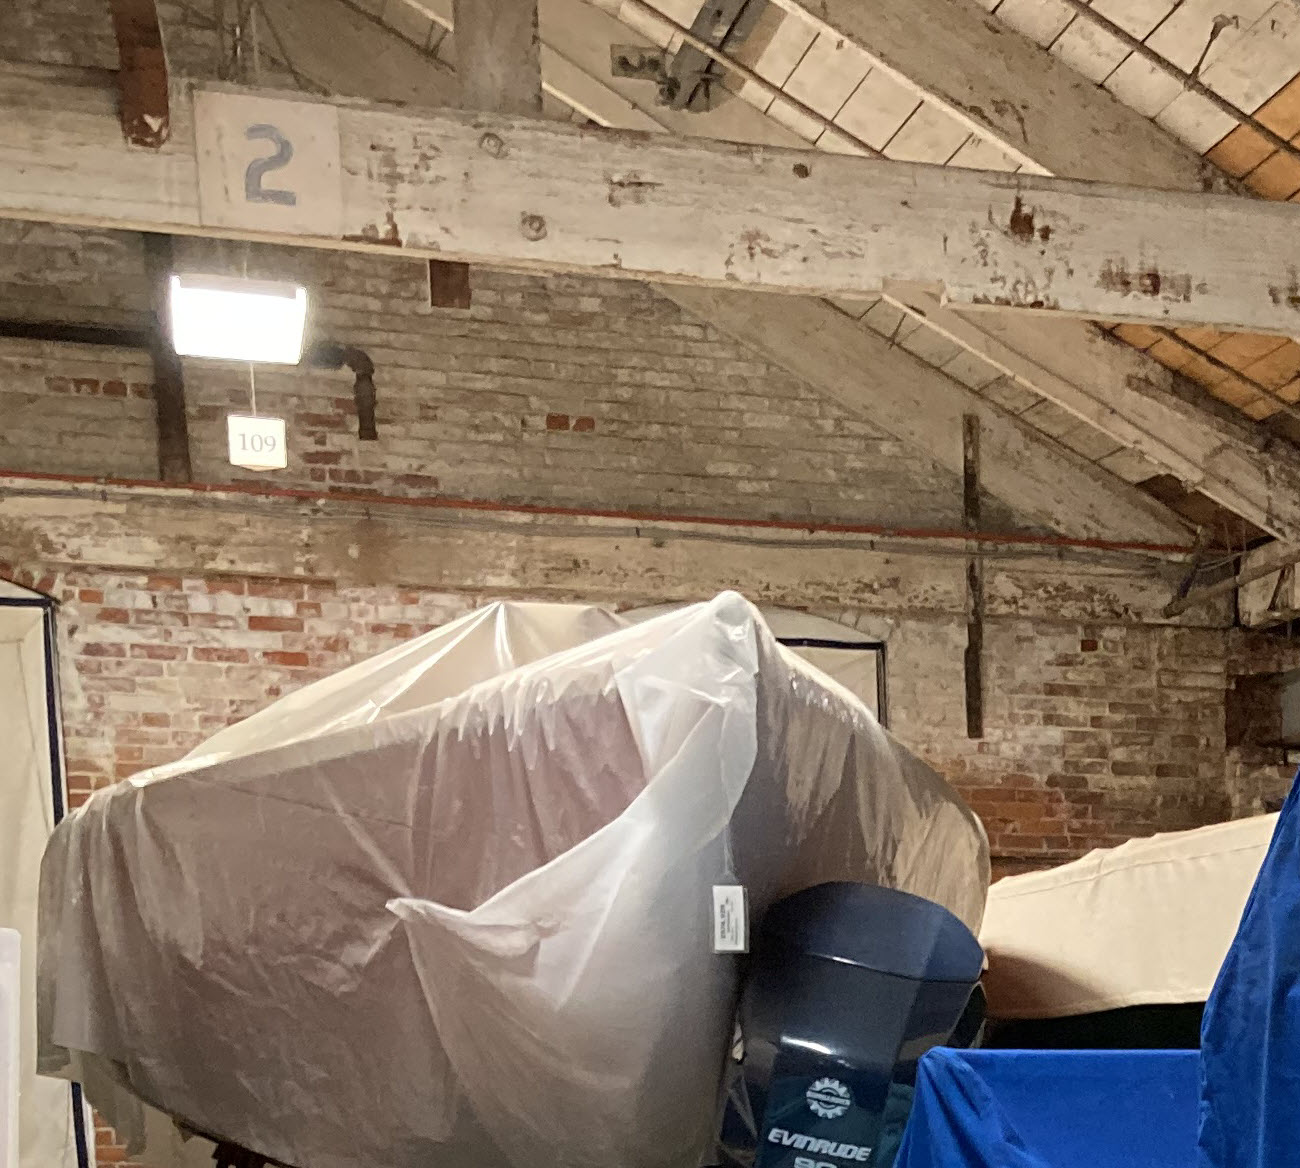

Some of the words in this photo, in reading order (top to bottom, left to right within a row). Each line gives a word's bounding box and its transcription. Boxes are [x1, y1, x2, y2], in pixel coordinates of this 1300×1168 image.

[244, 123, 297, 206] 2
[238, 433, 276, 452] 109
[767, 1127, 872, 1161] EVINRUDE
